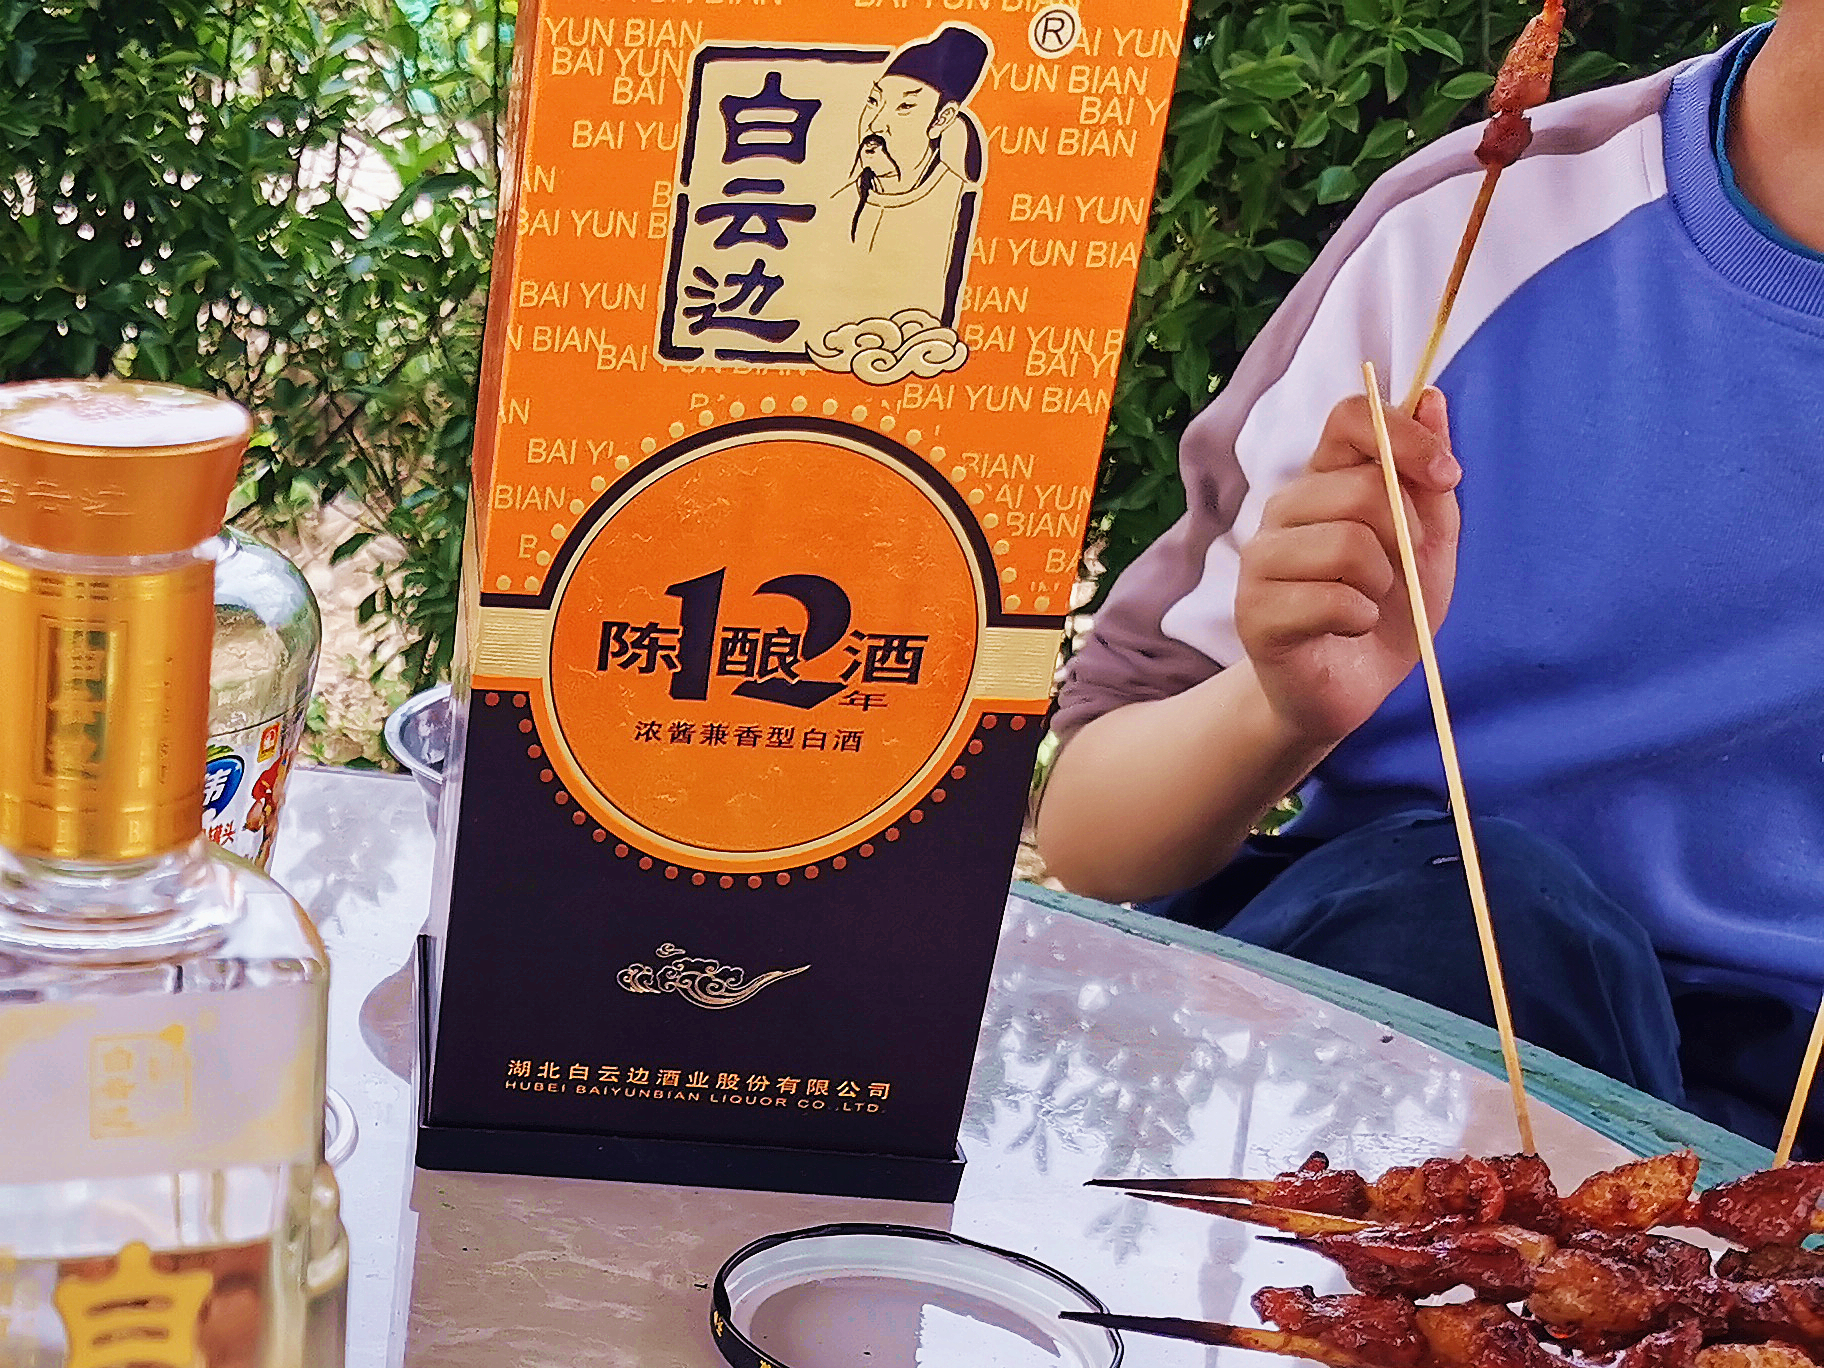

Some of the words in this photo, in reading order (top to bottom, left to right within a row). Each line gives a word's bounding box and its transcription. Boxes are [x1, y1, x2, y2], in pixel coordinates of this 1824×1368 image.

[545, 17, 614, 47] YUN
[625, 19, 703, 47] BIAN
[1114, 28, 1179, 58] YUN
[551, 47, 604, 76] BAI
[615, 49, 683, 77] YUN
[612, 77, 666, 105] BAI
[988, 63, 1060, 93] YUN
[1068, 65, 1149, 95] BIAN
[1079, 96, 1134, 126] BAI
[572, 120, 624, 150] BAI
[1057, 128, 1137, 158] BIAN
[682, 70, 822, 346] 白云边
[1009, 194, 1064, 223] BAI
[1075, 196, 1145, 225] YUN
[571, 210, 639, 239] YUN
[1008, 238, 1078, 267] YUN
[519, 281, 569, 308] BAI
[579, 282, 647, 311] YUN
[532, 326, 606, 354] BIAN
[964, 324, 1016, 352] BAI
[1027, 326, 1095, 355] YUN
[597, 345, 648, 372] BAI
[1027, 350, 1078, 378] BAI
[902, 383, 955, 411] BAI
[964, 384, 1033, 412] YUN
[1042, 386, 1112, 414] BIAN
[527, 438, 577, 465] BAI
[493, 485, 566, 512] BIAN
[986, 483, 1024, 510] AI
[1006, 512, 1081, 538] BIAN
[838, 690, 889, 713] 年
[634, 719, 866, 753] 浓酱兼香型白酒
[505, 1080, 566, 1093] HUBEI
[576, 1085, 700, 1102] BAIYUNBIAN
[710, 1093, 787, 1108] LIQUOR
[507, 1059, 891, 1100] 湖北白云边酒业股份有限公司
